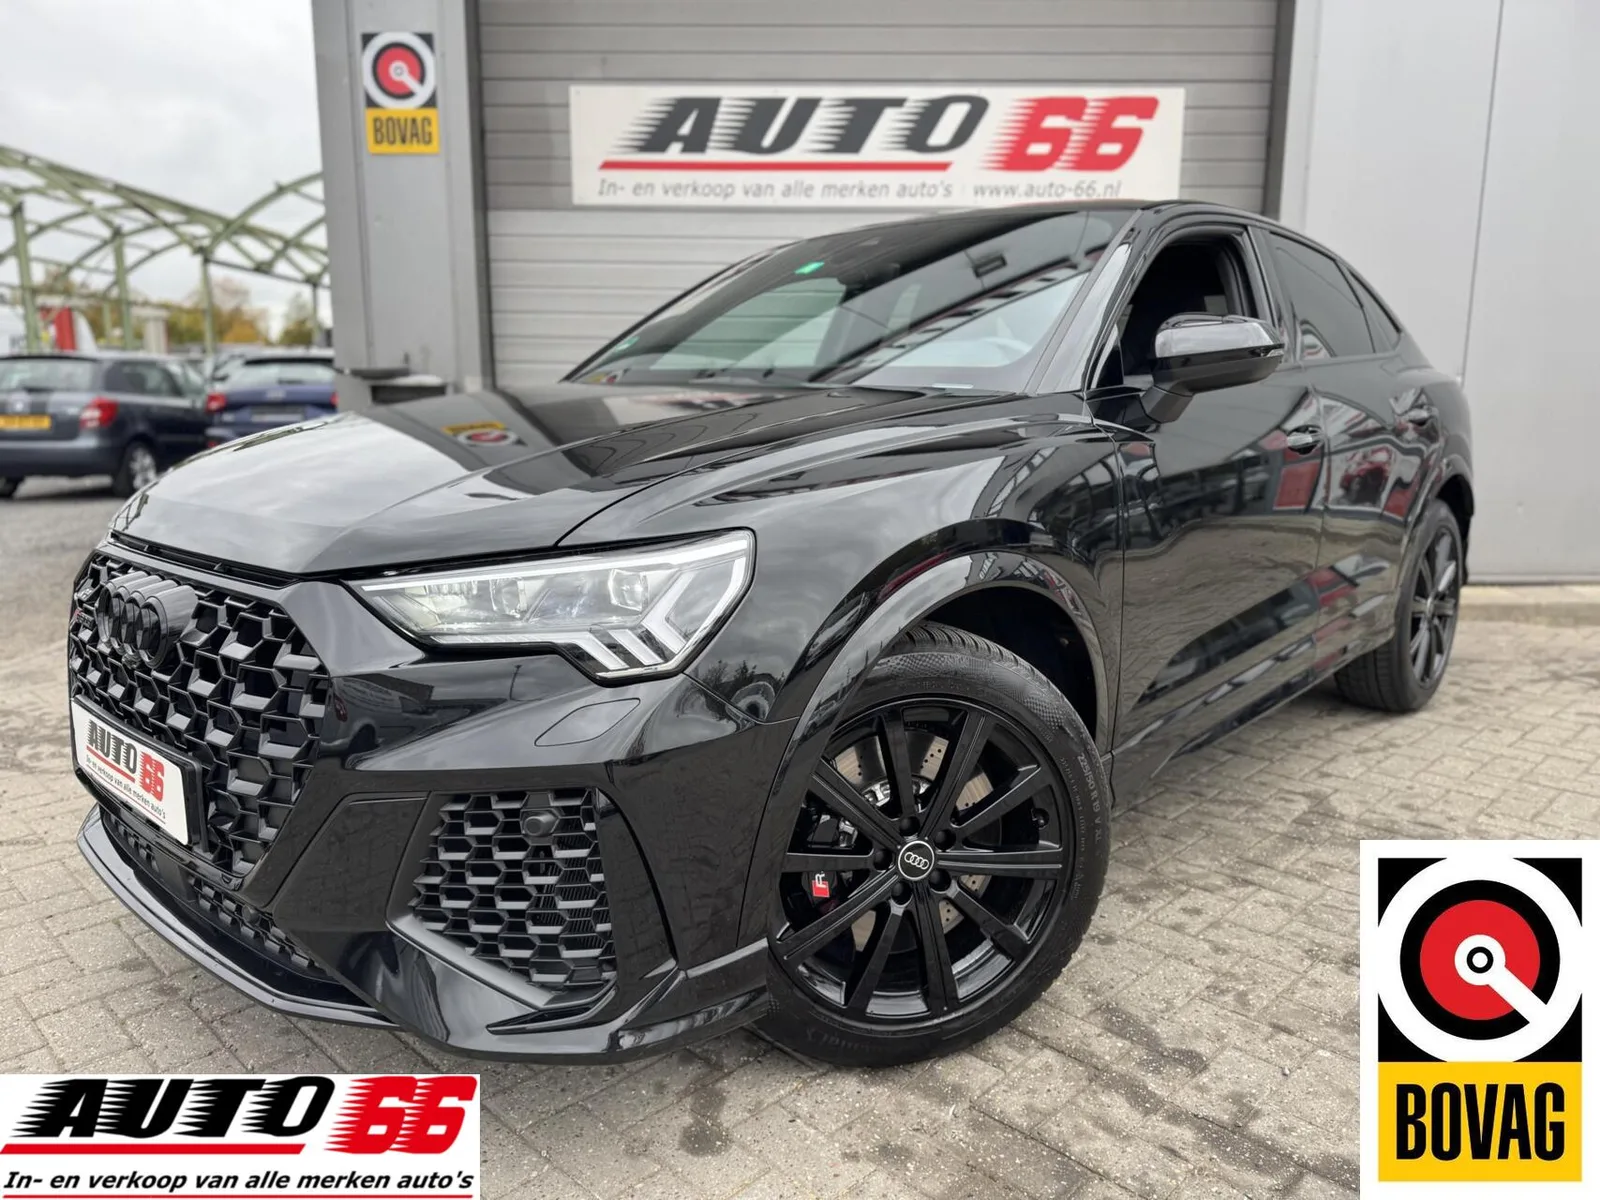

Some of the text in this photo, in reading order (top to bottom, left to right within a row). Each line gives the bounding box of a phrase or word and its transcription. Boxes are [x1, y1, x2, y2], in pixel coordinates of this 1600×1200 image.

[374, 117, 432, 145] BOVAG
[609, 95, 1160, 172] AUTO 66
[598, 178, 1123, 201] In- en verkoop van alle merken auto's www.auto-66.nl
[87, 719, 165, 802] AUTO 66
